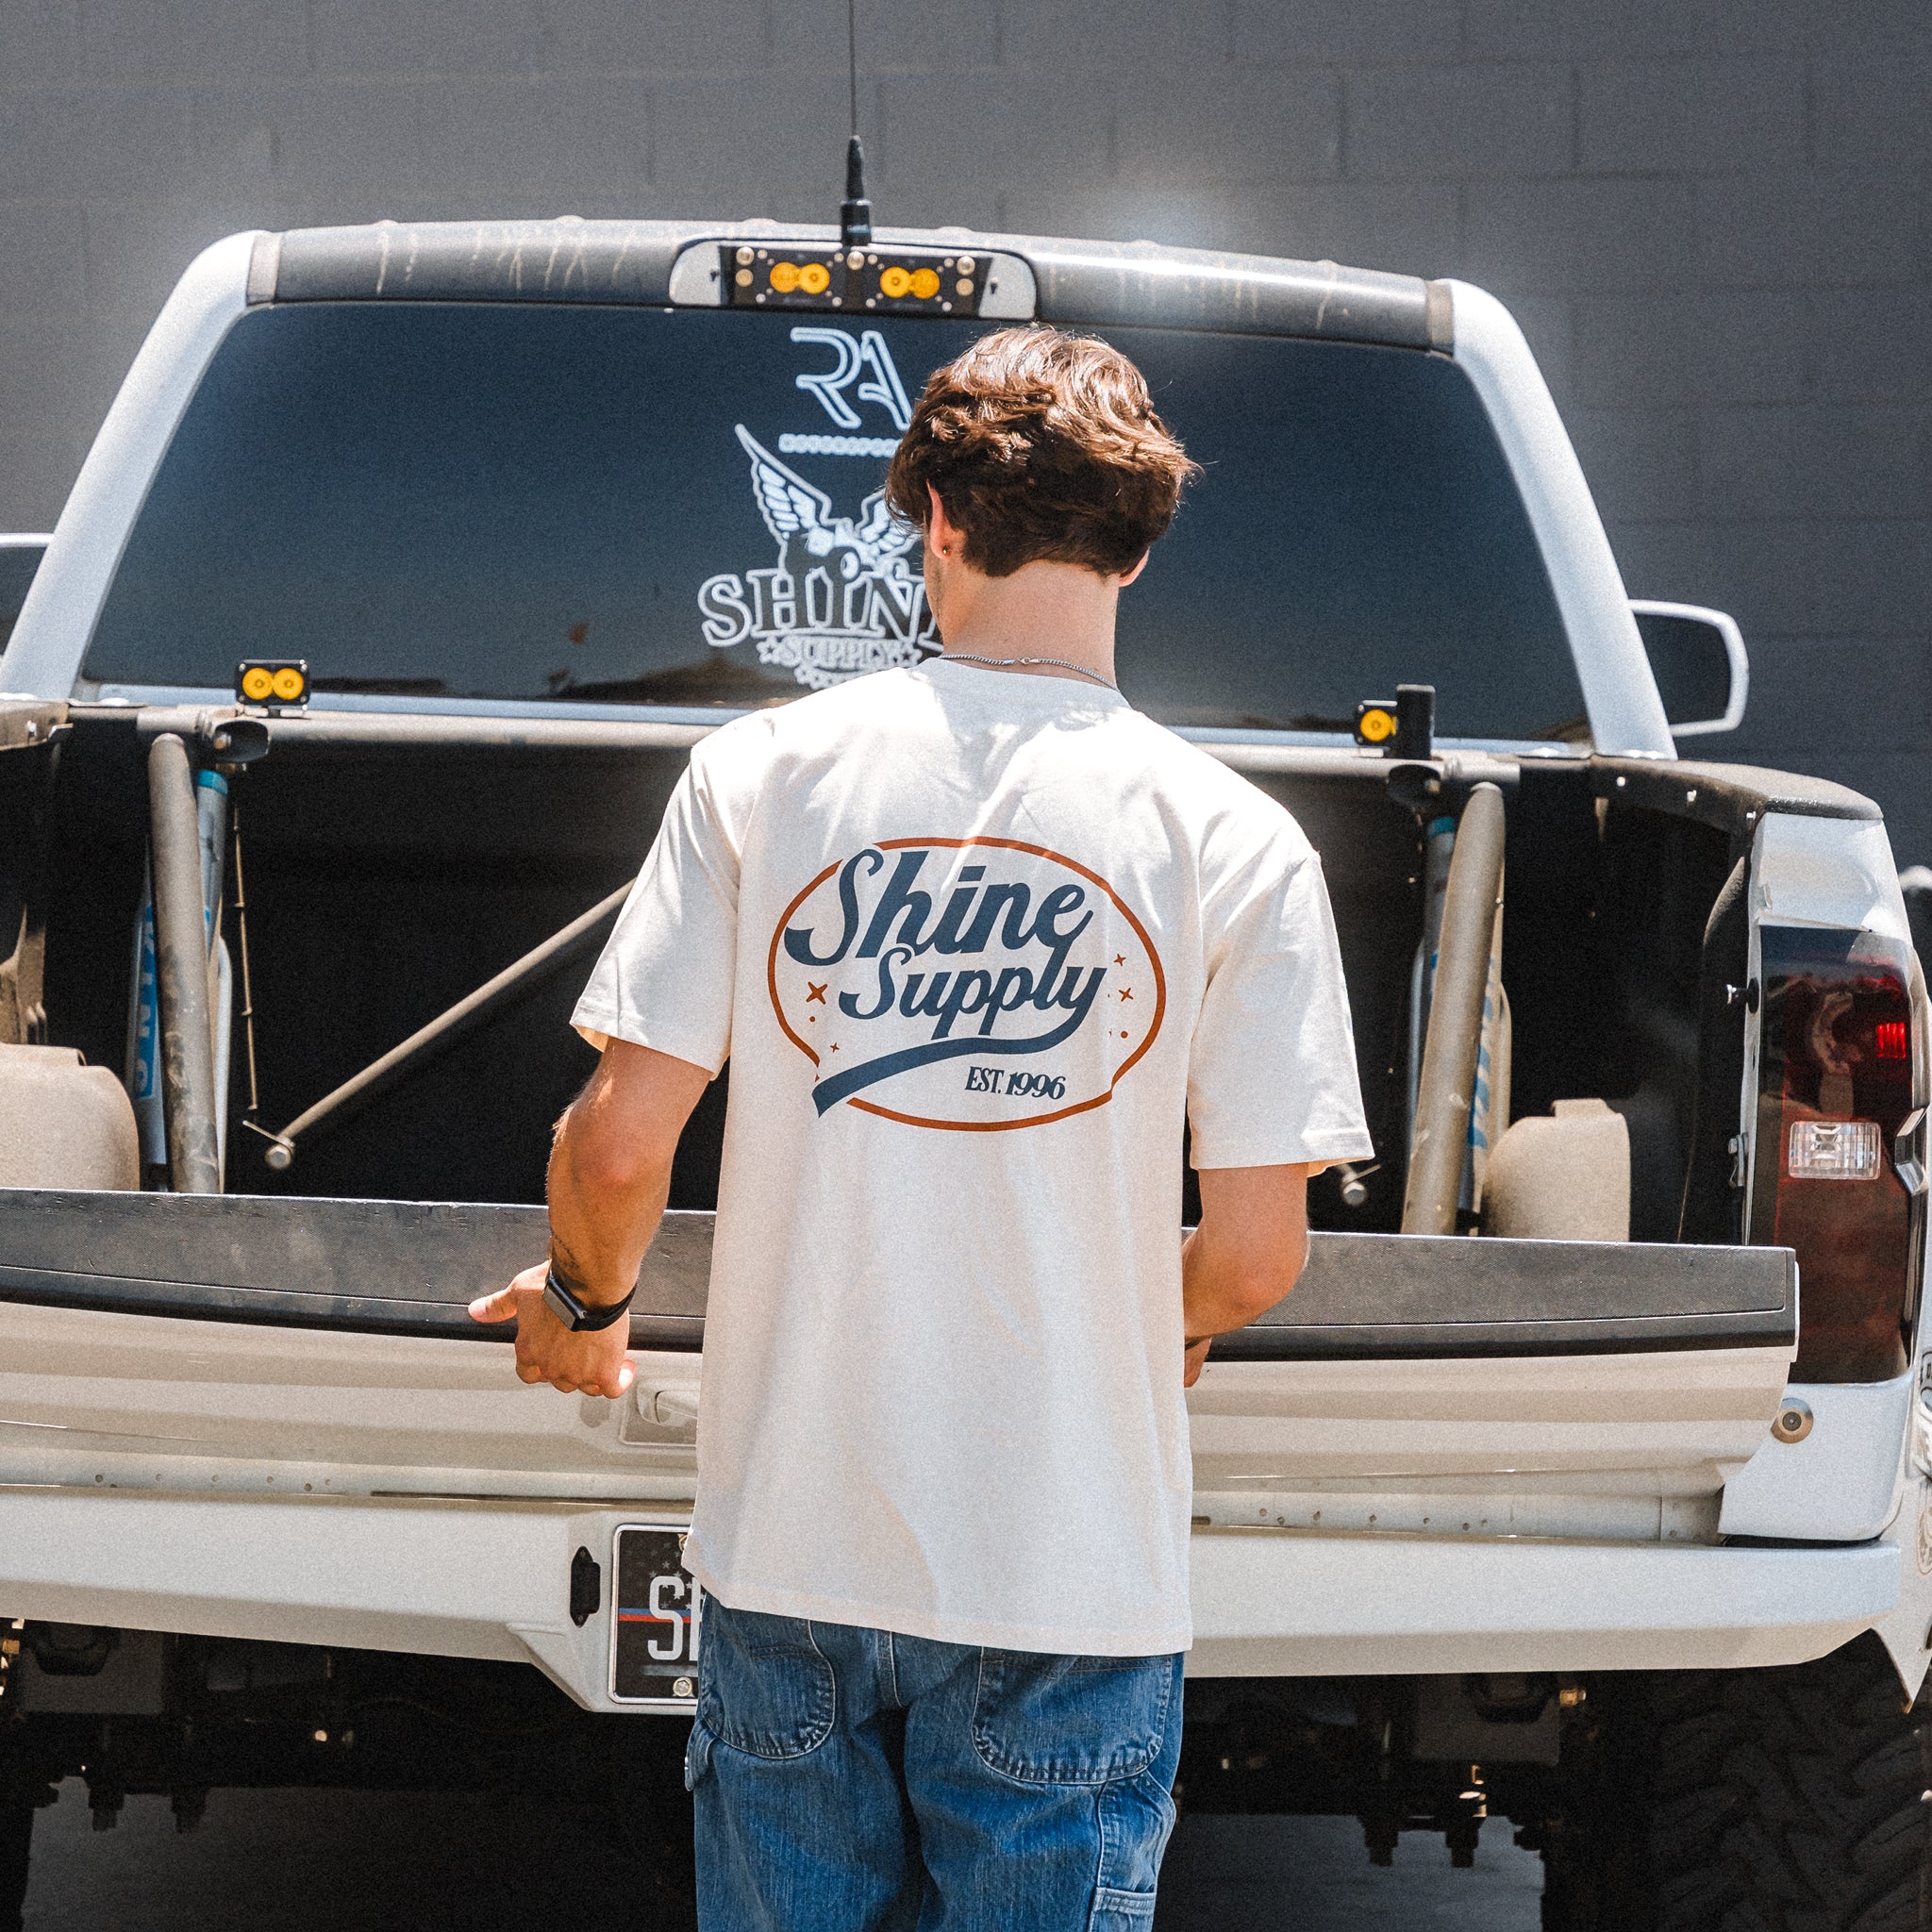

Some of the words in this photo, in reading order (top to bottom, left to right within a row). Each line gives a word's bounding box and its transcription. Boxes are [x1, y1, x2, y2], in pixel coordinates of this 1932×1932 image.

[784, 849, 1093, 965] Shine
[835, 945, 1107, 1058] Supply
[965, 1066, 1005, 1093] EST.
[1005, 1072, 1066, 1100] 1996
